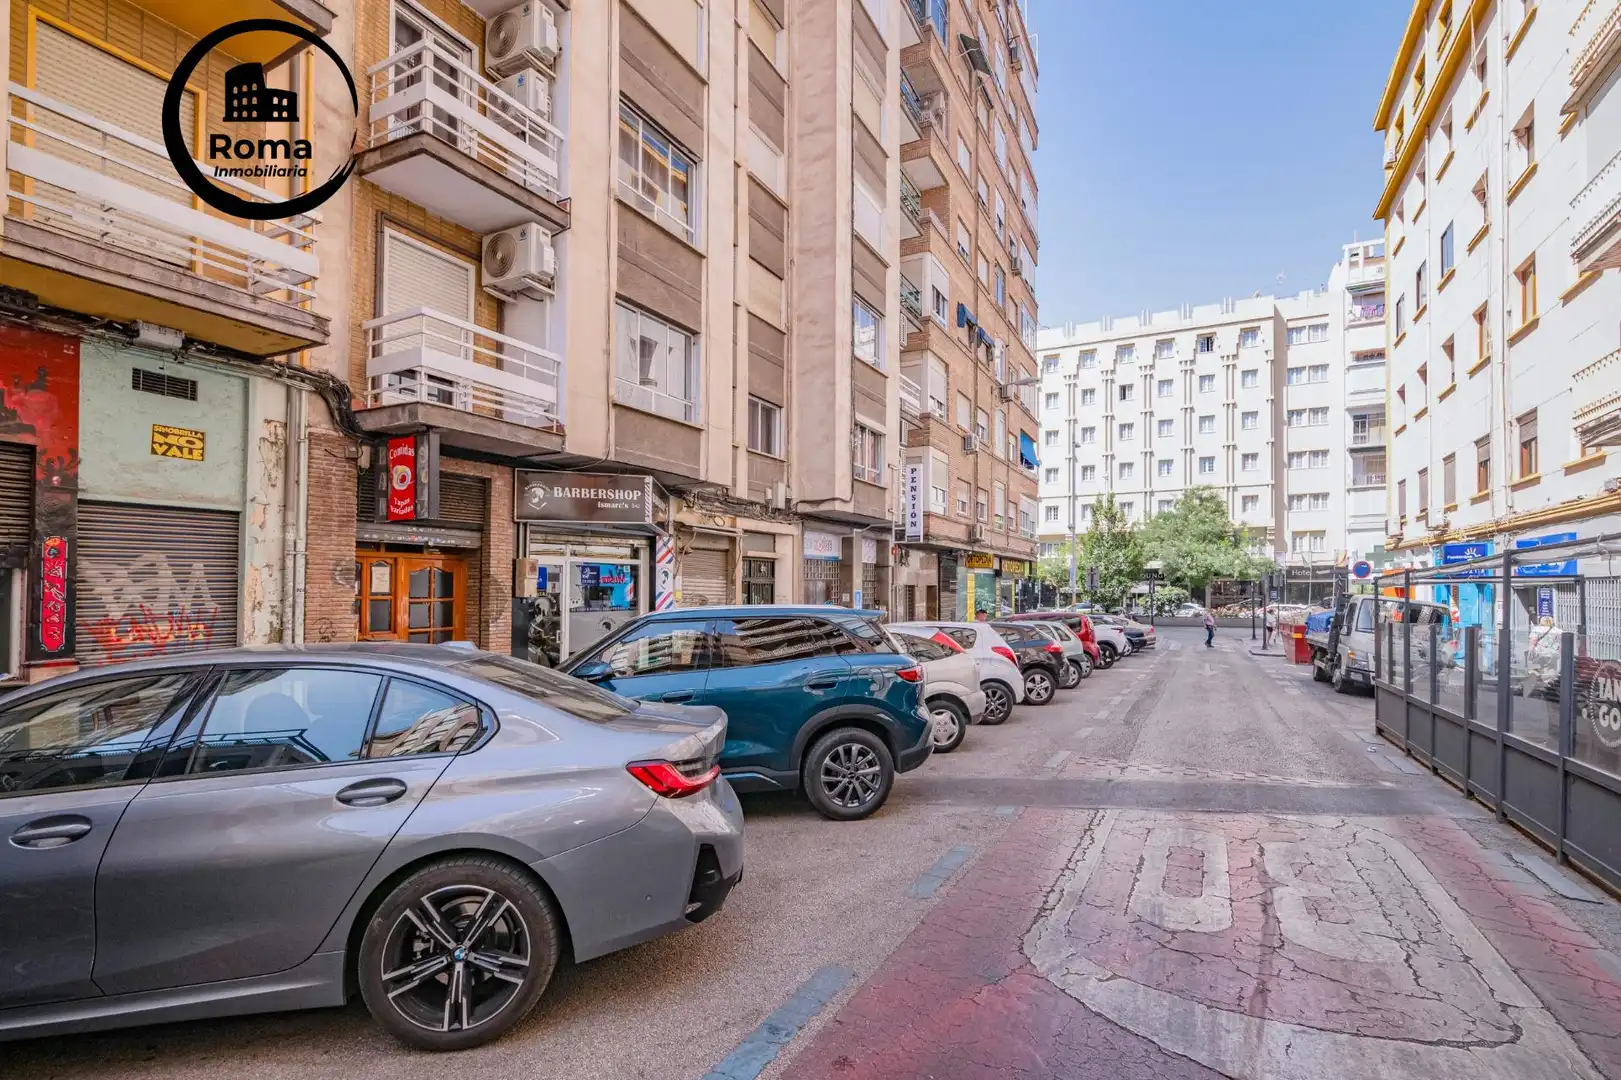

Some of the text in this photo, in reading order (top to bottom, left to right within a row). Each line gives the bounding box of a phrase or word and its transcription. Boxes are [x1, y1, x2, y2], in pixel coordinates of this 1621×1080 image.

[153, 432, 203, 449] NO
[152, 443, 203, 460] VALE
[389, 443, 415, 460] Comidas
[553, 486, 642, 501] BARBERSHOP
[394, 497, 411, 509] Tapas
